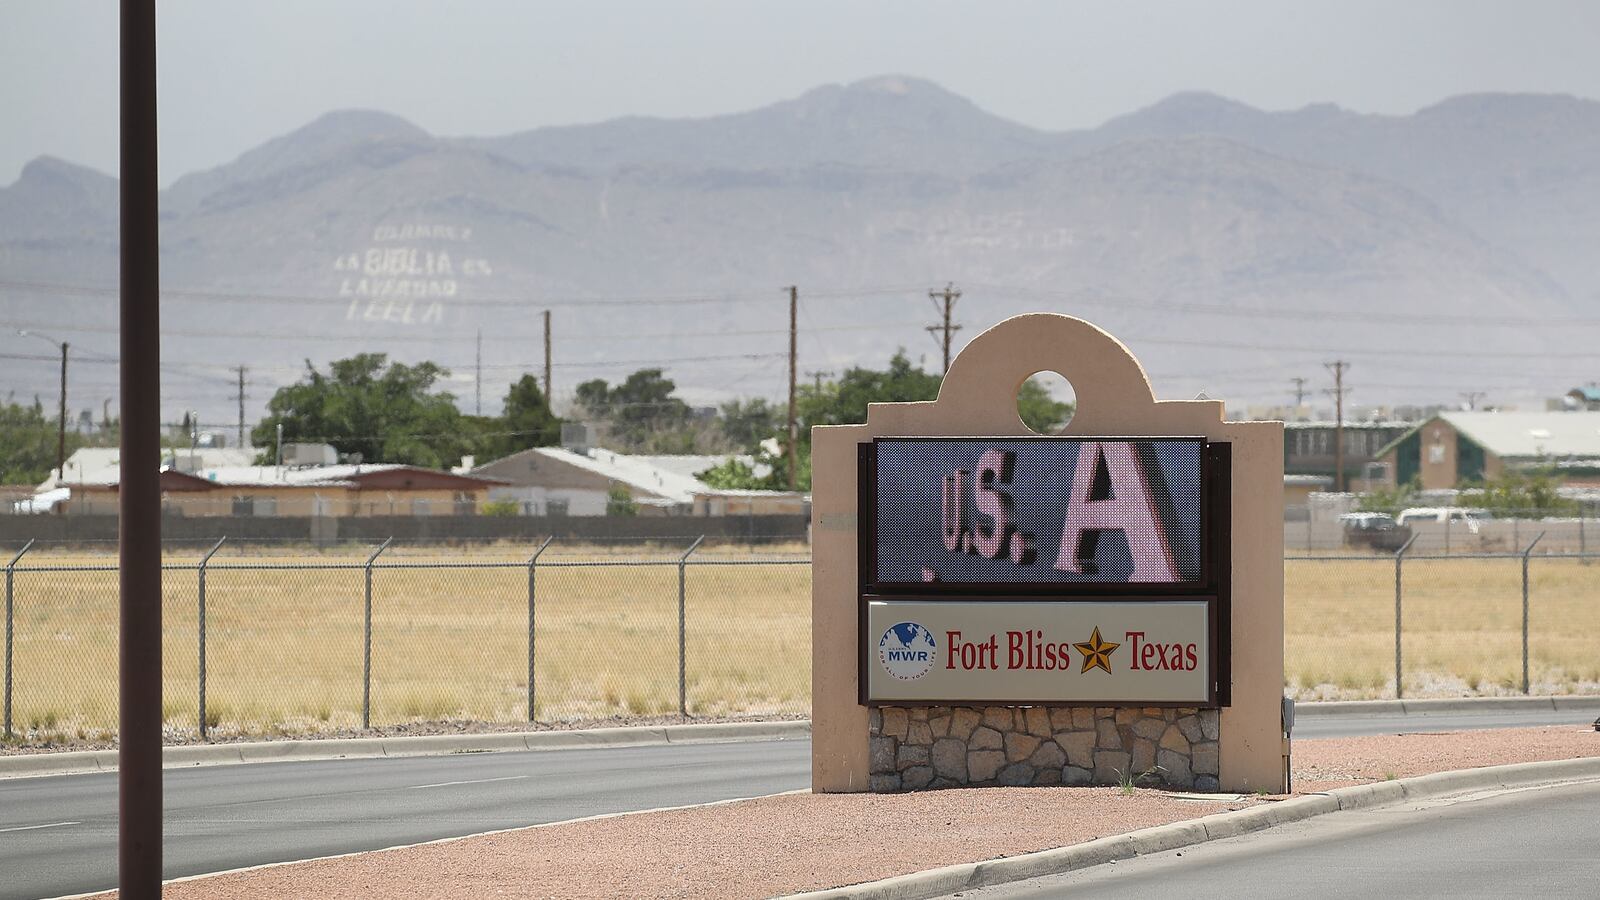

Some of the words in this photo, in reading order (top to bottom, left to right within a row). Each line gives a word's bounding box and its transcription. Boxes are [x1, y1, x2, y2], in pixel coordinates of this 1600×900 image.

[364, 248, 451, 276] BIBLIA
[888, 651, 928, 662] MWR
[945, 630, 999, 671] Fort
[1006, 629, 1071, 671] Bliss
[1125, 631, 1198, 671] Texas
